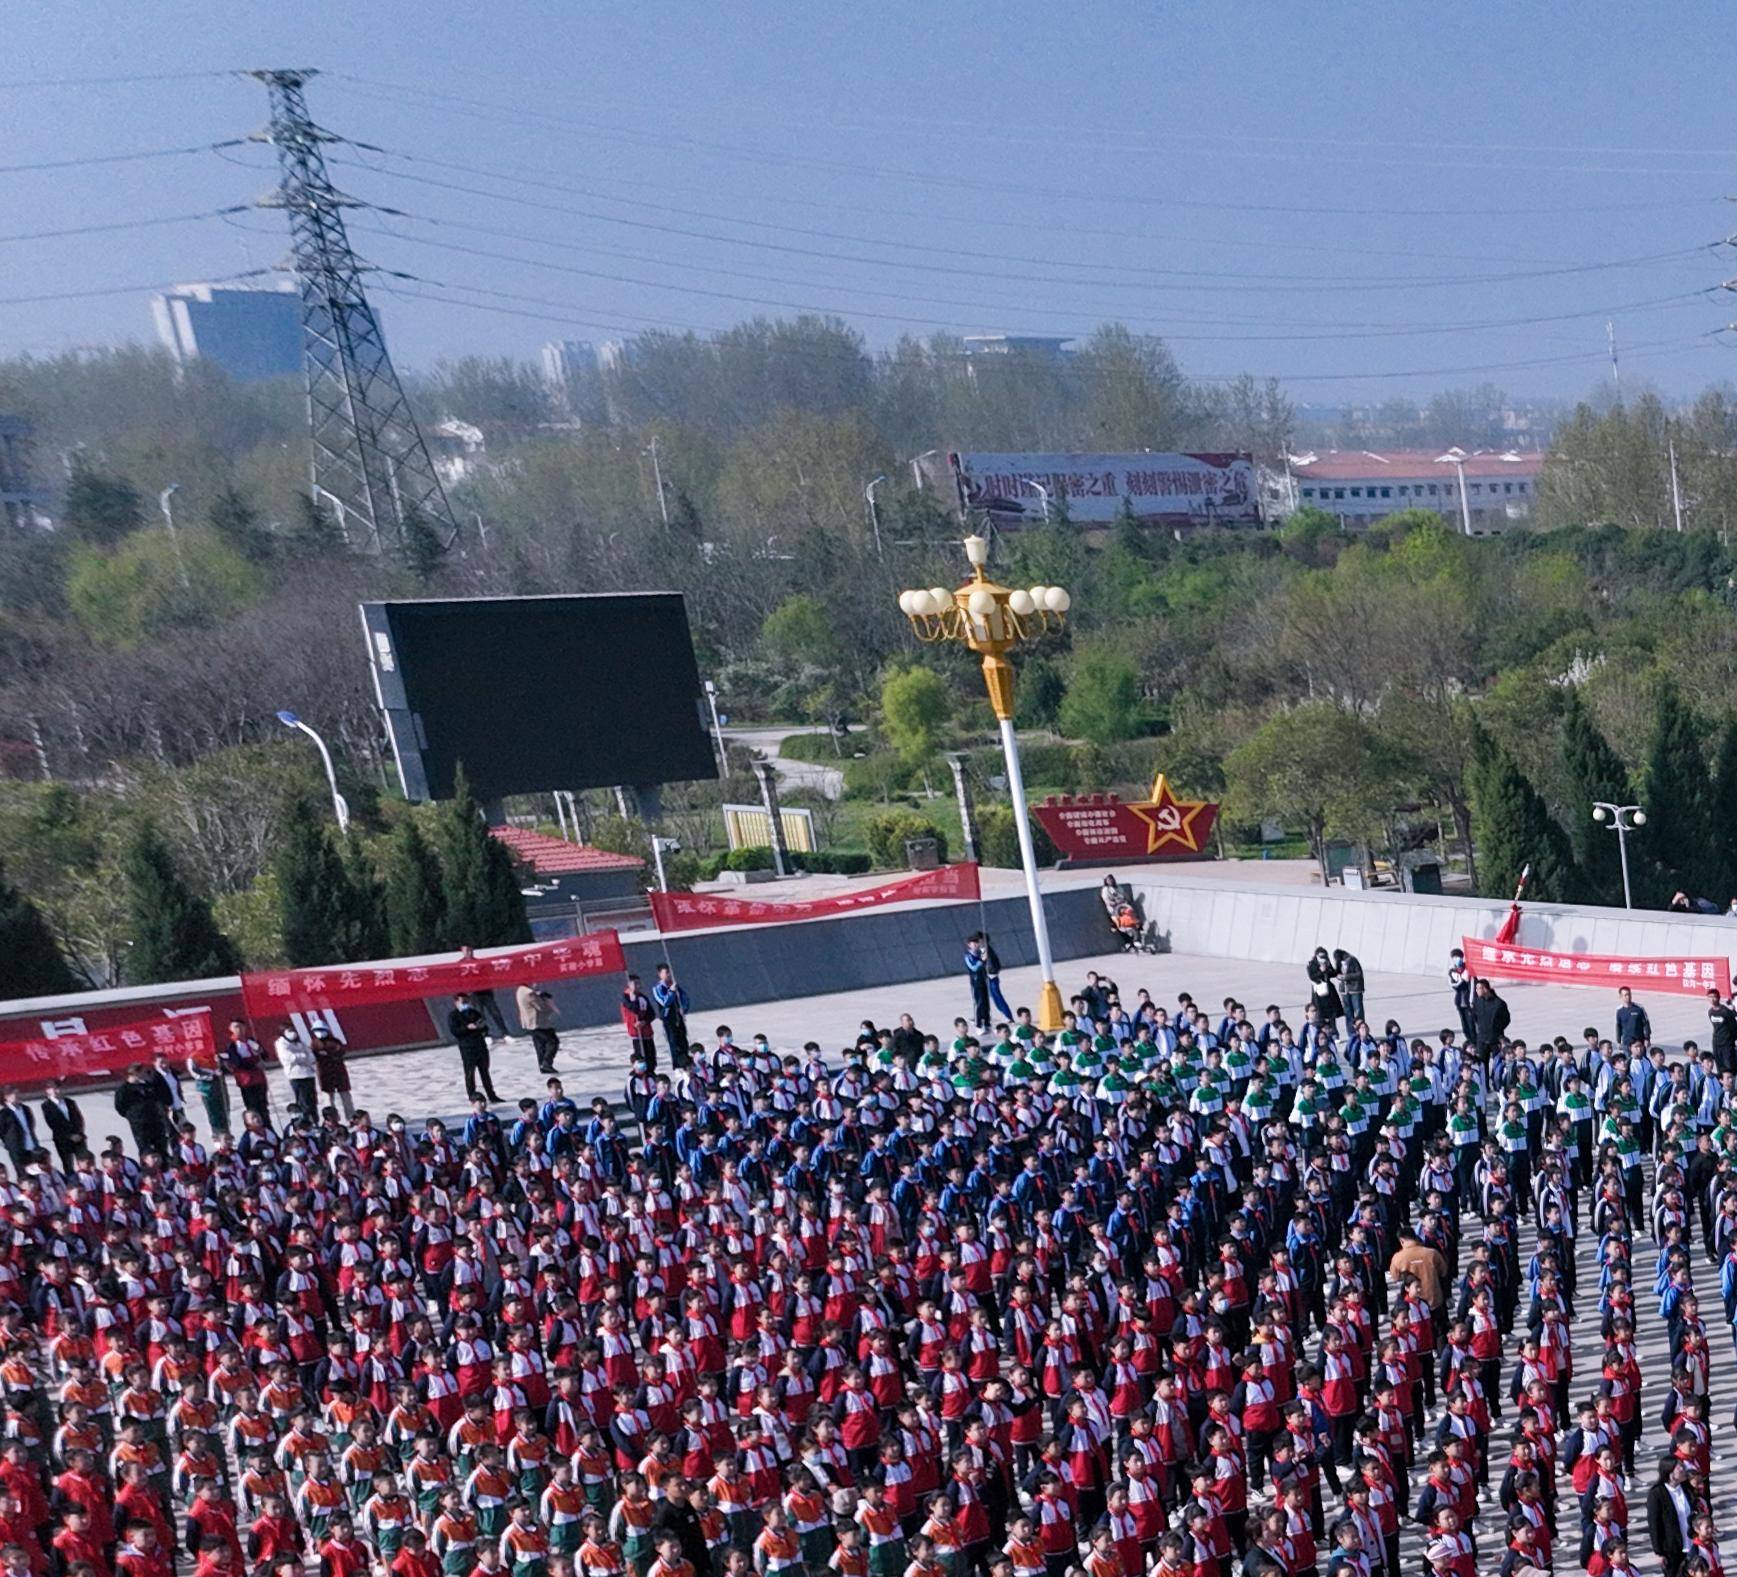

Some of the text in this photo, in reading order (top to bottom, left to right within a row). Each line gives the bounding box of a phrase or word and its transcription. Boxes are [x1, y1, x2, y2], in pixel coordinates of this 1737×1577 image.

[25, 1018, 204, 1062] 传承红色基因
